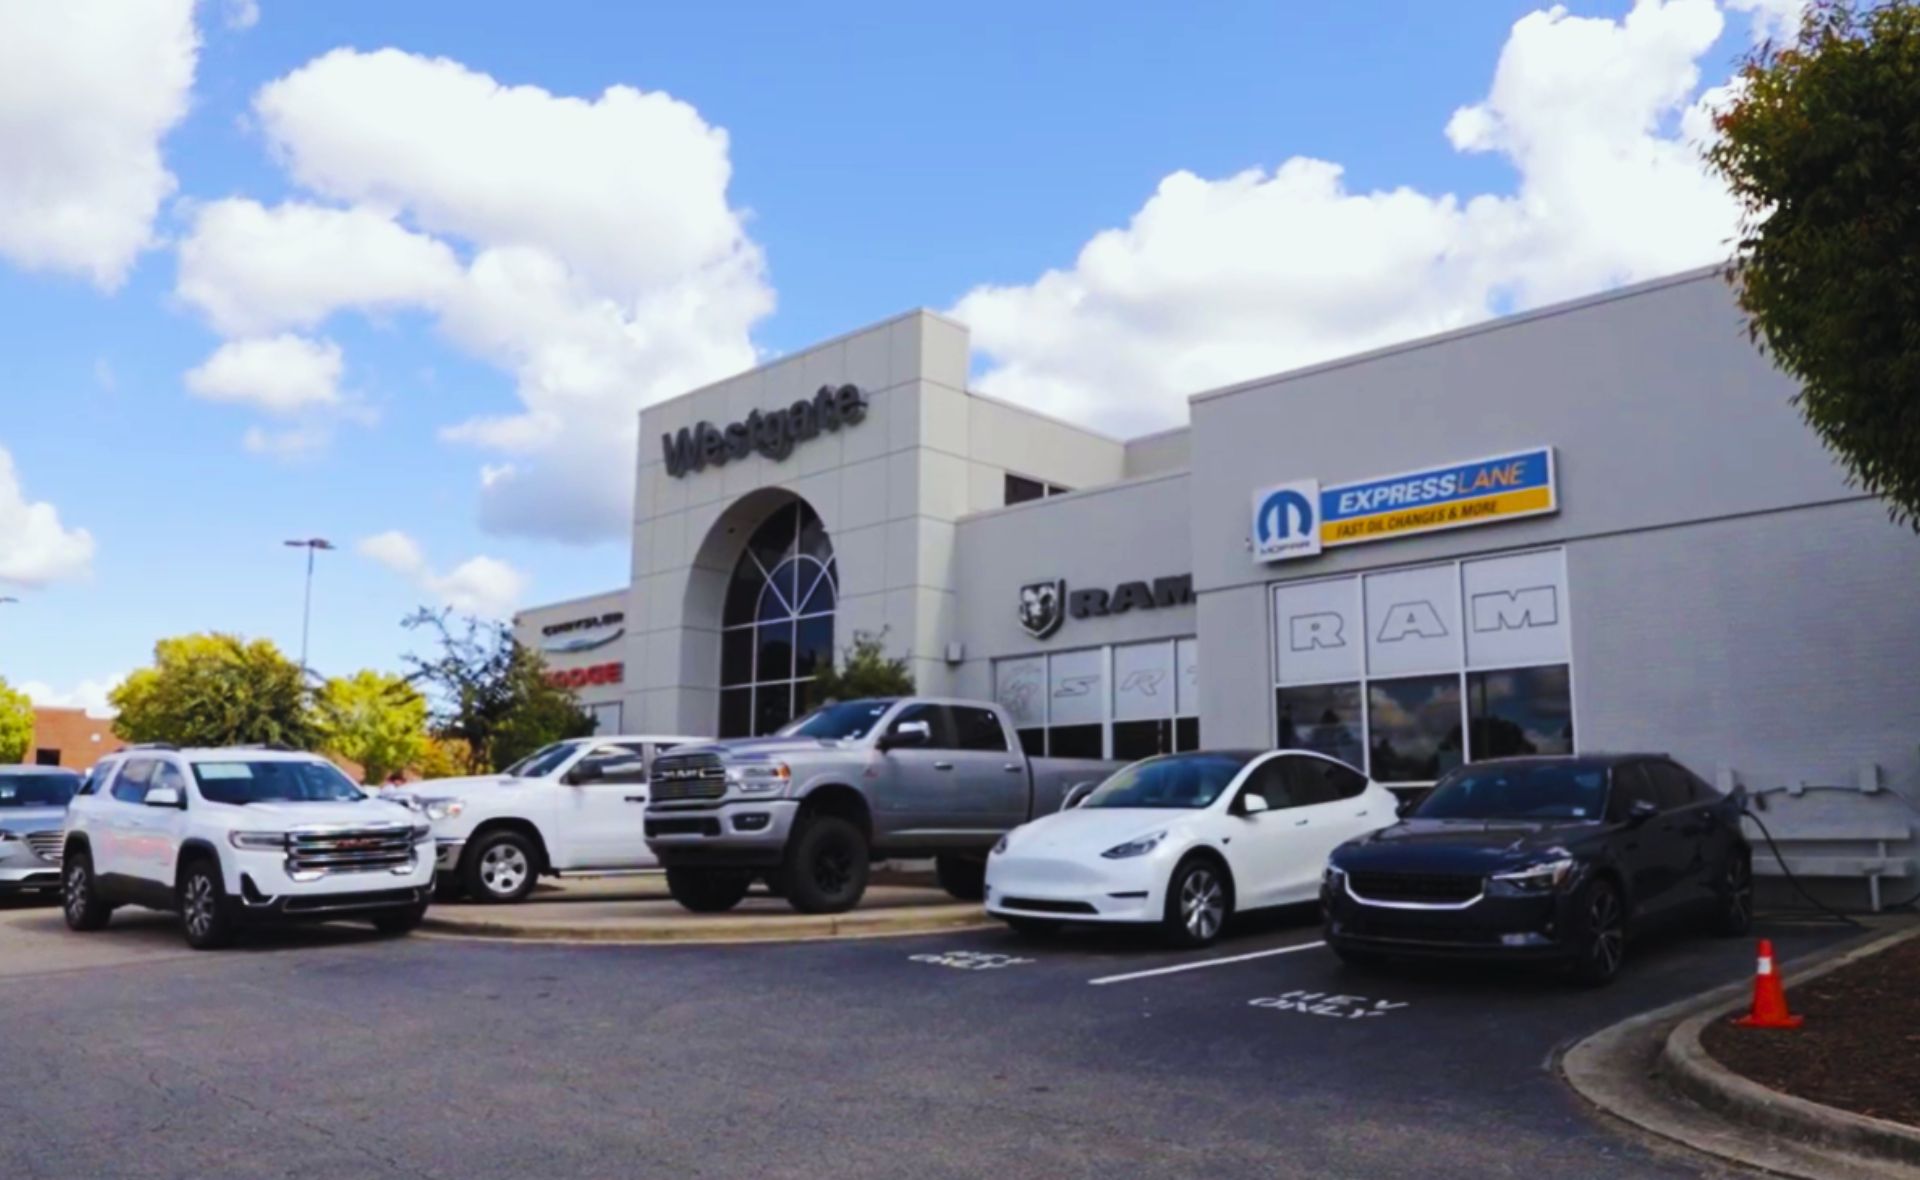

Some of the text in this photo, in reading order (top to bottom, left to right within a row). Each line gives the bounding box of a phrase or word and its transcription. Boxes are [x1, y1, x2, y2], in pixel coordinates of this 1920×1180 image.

[662, 384, 869, 479] Westgate
[1336, 501, 1498, 538] FAST OIL CHANGES & MORE
[1070, 572, 1197, 619] RAM
